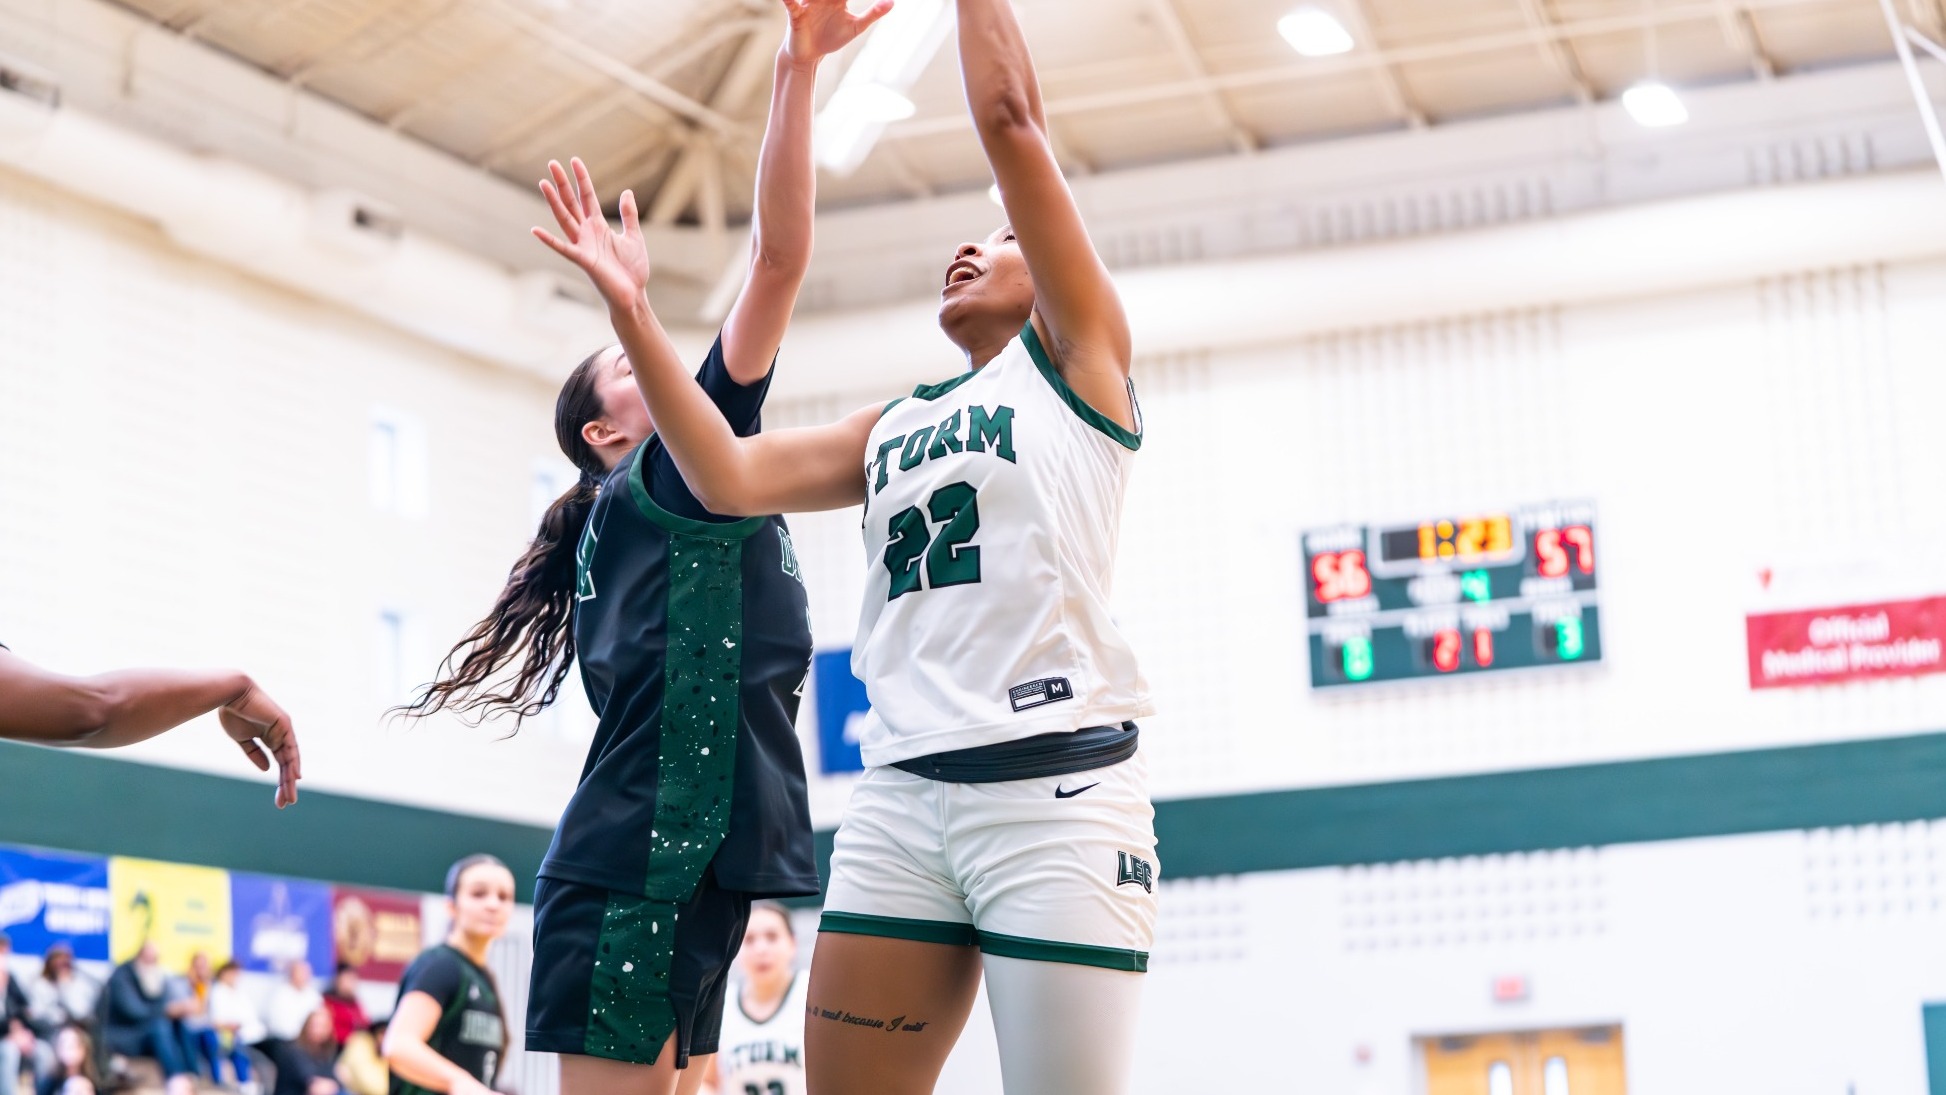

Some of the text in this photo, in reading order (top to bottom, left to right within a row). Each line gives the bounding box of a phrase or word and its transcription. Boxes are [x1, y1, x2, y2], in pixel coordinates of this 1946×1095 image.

[884, 481, 981, 602] 22
[1535, 523, 1594, 578] 57
[1311, 549, 1371, 603] 56
[1051, 682, 1063, 694] M
[842, 1012, 884, 1029] because
